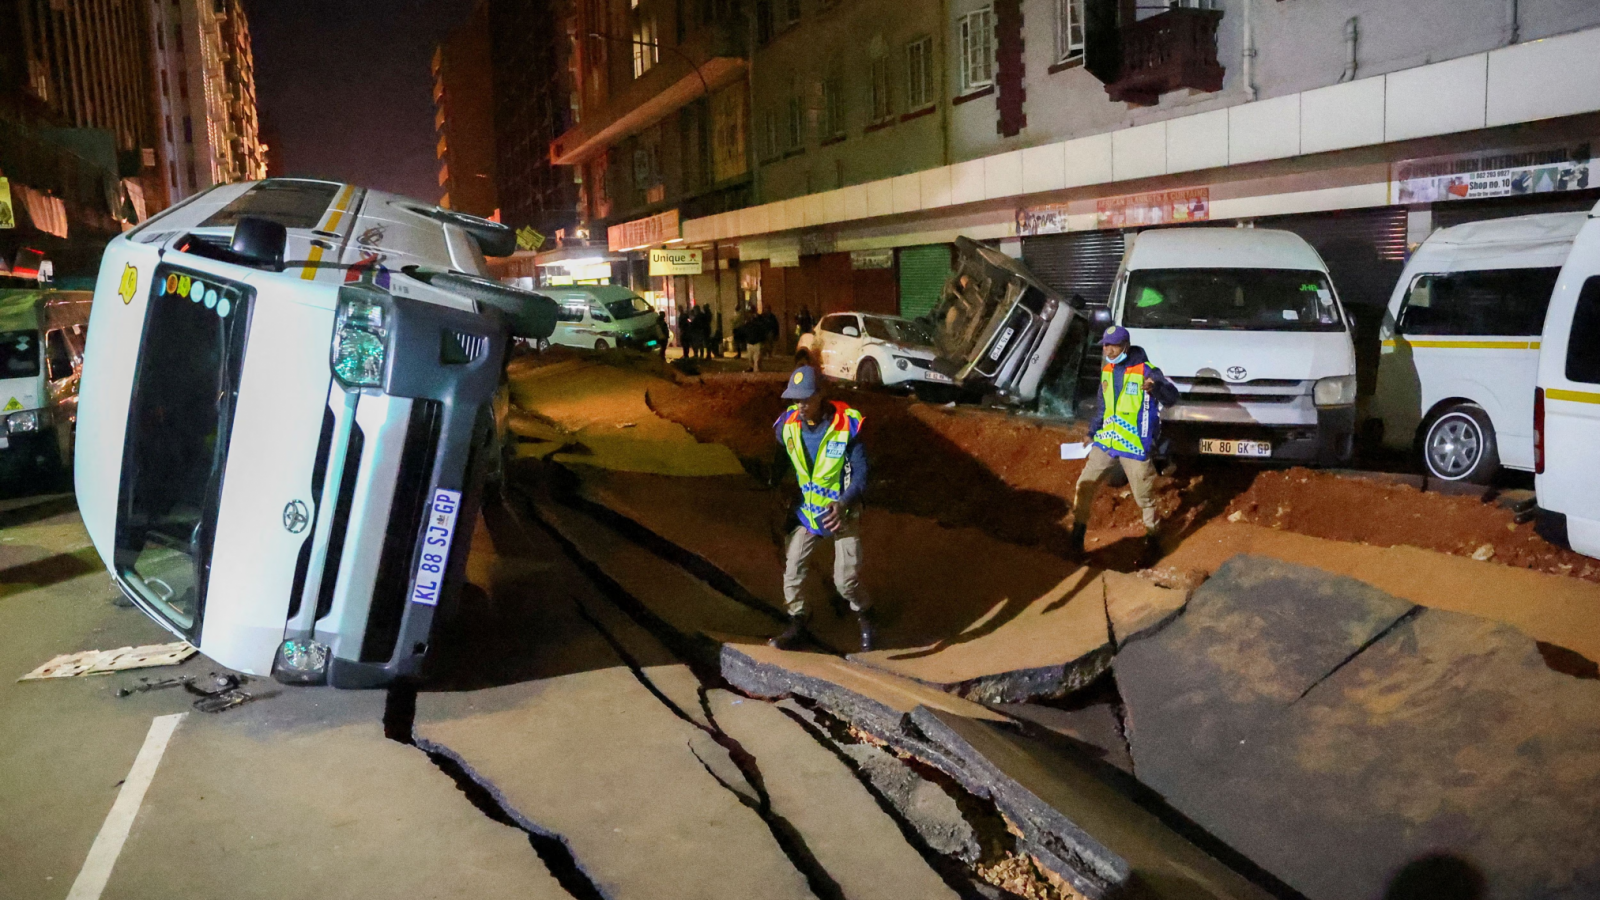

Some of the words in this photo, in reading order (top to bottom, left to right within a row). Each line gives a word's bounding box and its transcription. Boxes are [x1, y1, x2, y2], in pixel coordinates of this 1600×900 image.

[1469, 181, 1488, 191] Shop
[1489, 180, 1500, 189] no.
[1502, 178, 1510, 188] 10
[653, 253, 686, 265] Unique
[1201, 440, 1213, 452] HK
[1219, 441, 1231, 453] 80
[1237, 442, 1249, 454] GK
[1257, 443, 1270, 454] GP
[434, 494, 456, 514] GP
[427, 526, 449, 547] SJ
[421, 553, 443, 574] 88
[414, 581, 437, 601] KL
